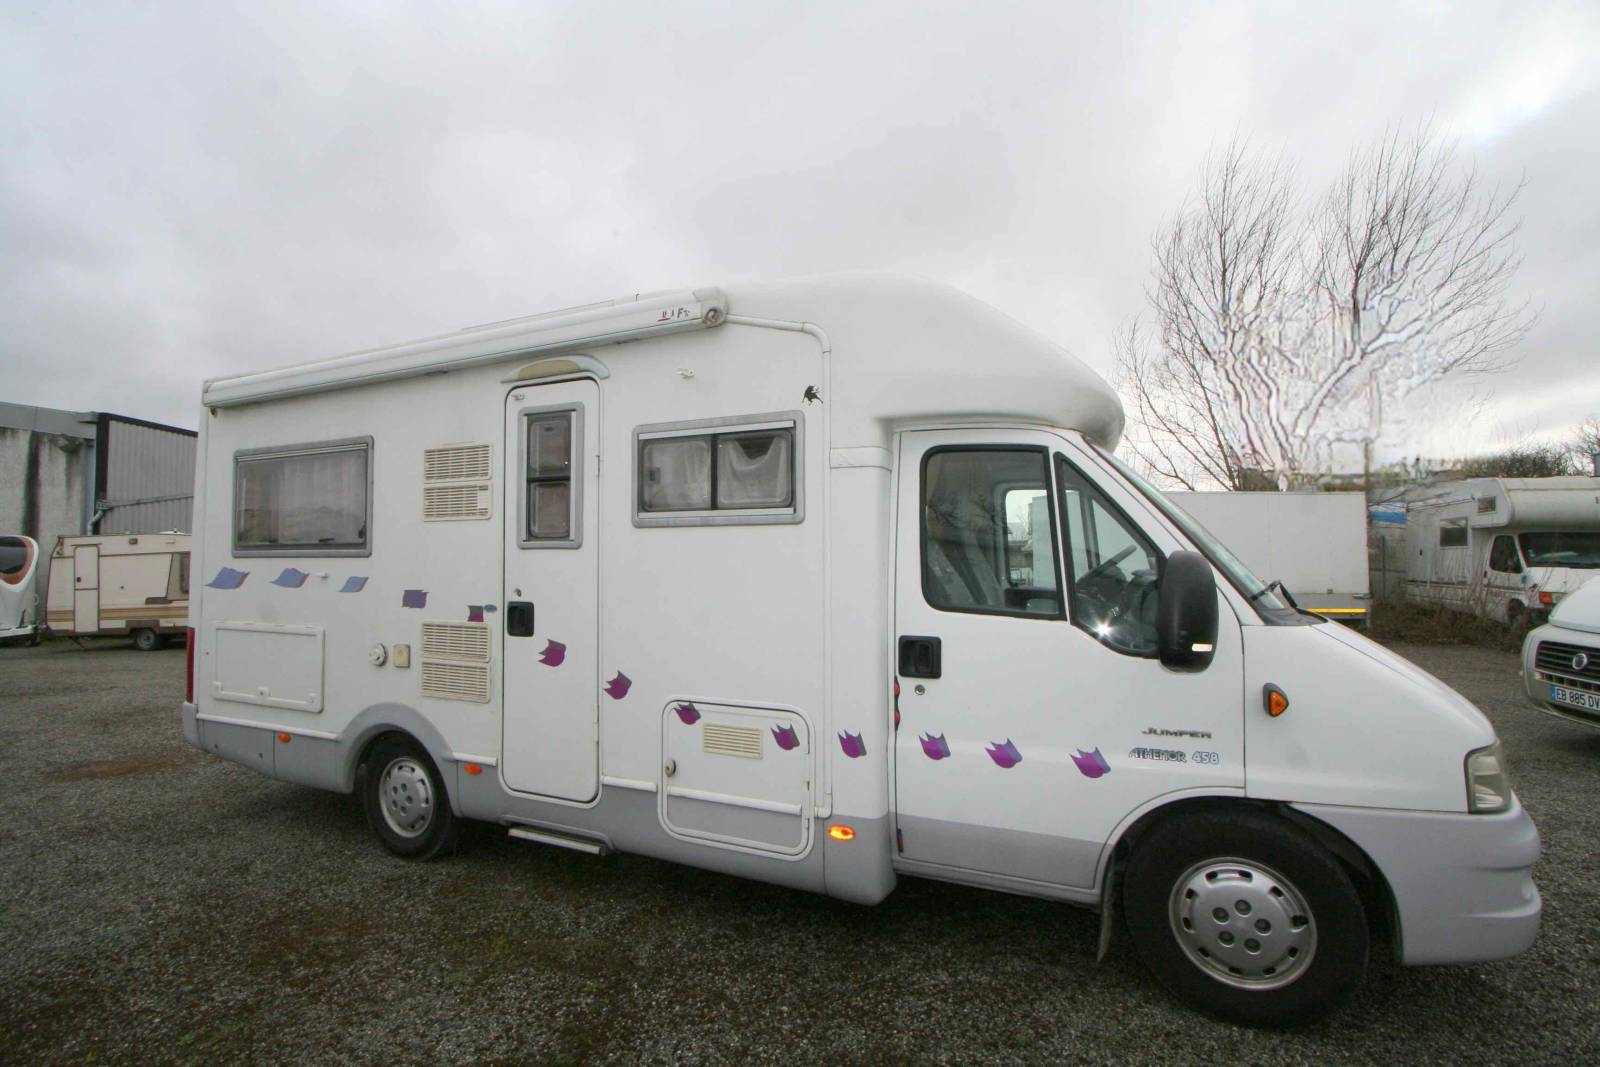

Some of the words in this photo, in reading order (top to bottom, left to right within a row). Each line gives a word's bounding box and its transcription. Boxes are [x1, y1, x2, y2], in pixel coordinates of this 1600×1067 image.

[1556, 688, 1567, 701] EB
[1569, 691, 1585, 706] 885
[1141, 727, 1212, 739] JUMPER
[1128, 747, 1187, 763] ATHENOR
[1192, 751, 1219, 765] 458
